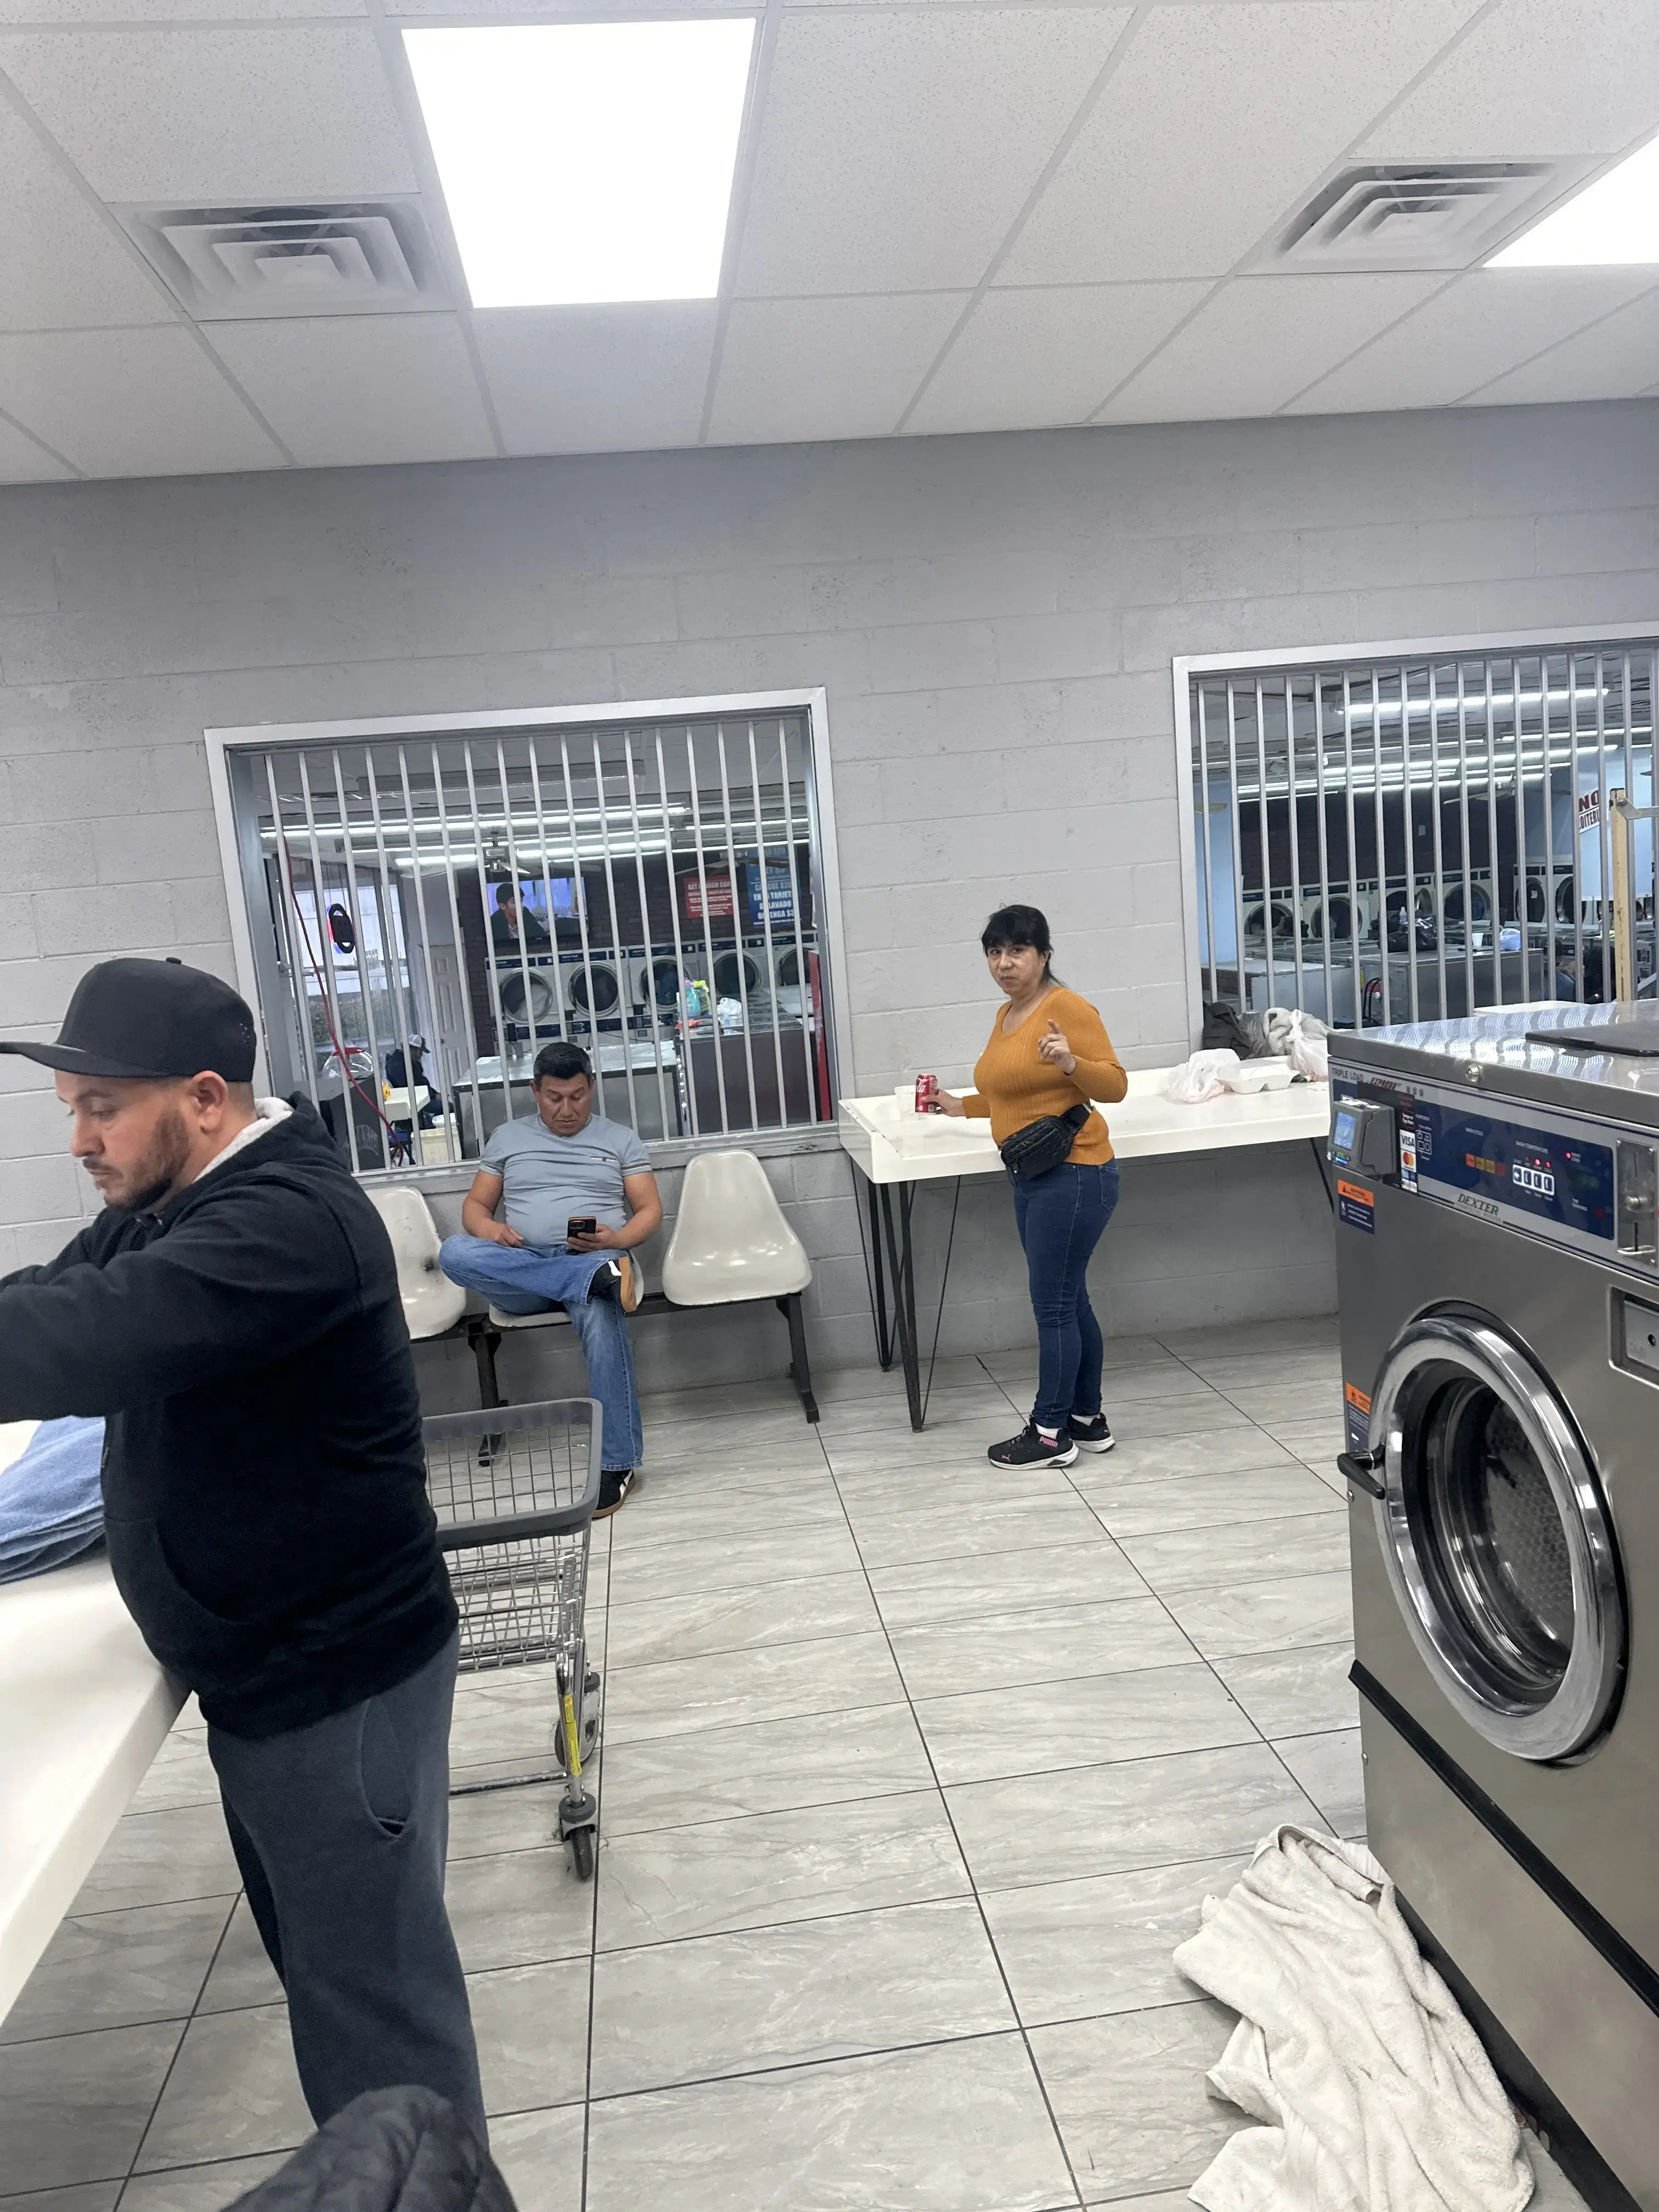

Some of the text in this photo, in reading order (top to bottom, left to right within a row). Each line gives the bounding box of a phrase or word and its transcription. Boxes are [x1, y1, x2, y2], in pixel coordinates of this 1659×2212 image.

[1578, 789, 1599, 812] NO
[770, 890, 793, 899] TARJET
[768, 900, 792, 909] LAVADO
[1332, 1068, 1348, 1079] TRIPLE
[1350, 1071, 1364, 1081] LOAD
[1401, 1134, 1415, 1148] VISA
[1458, 1193, 1499, 1216] DEXTER
[1040, 1436, 1059, 1448] PUMA
